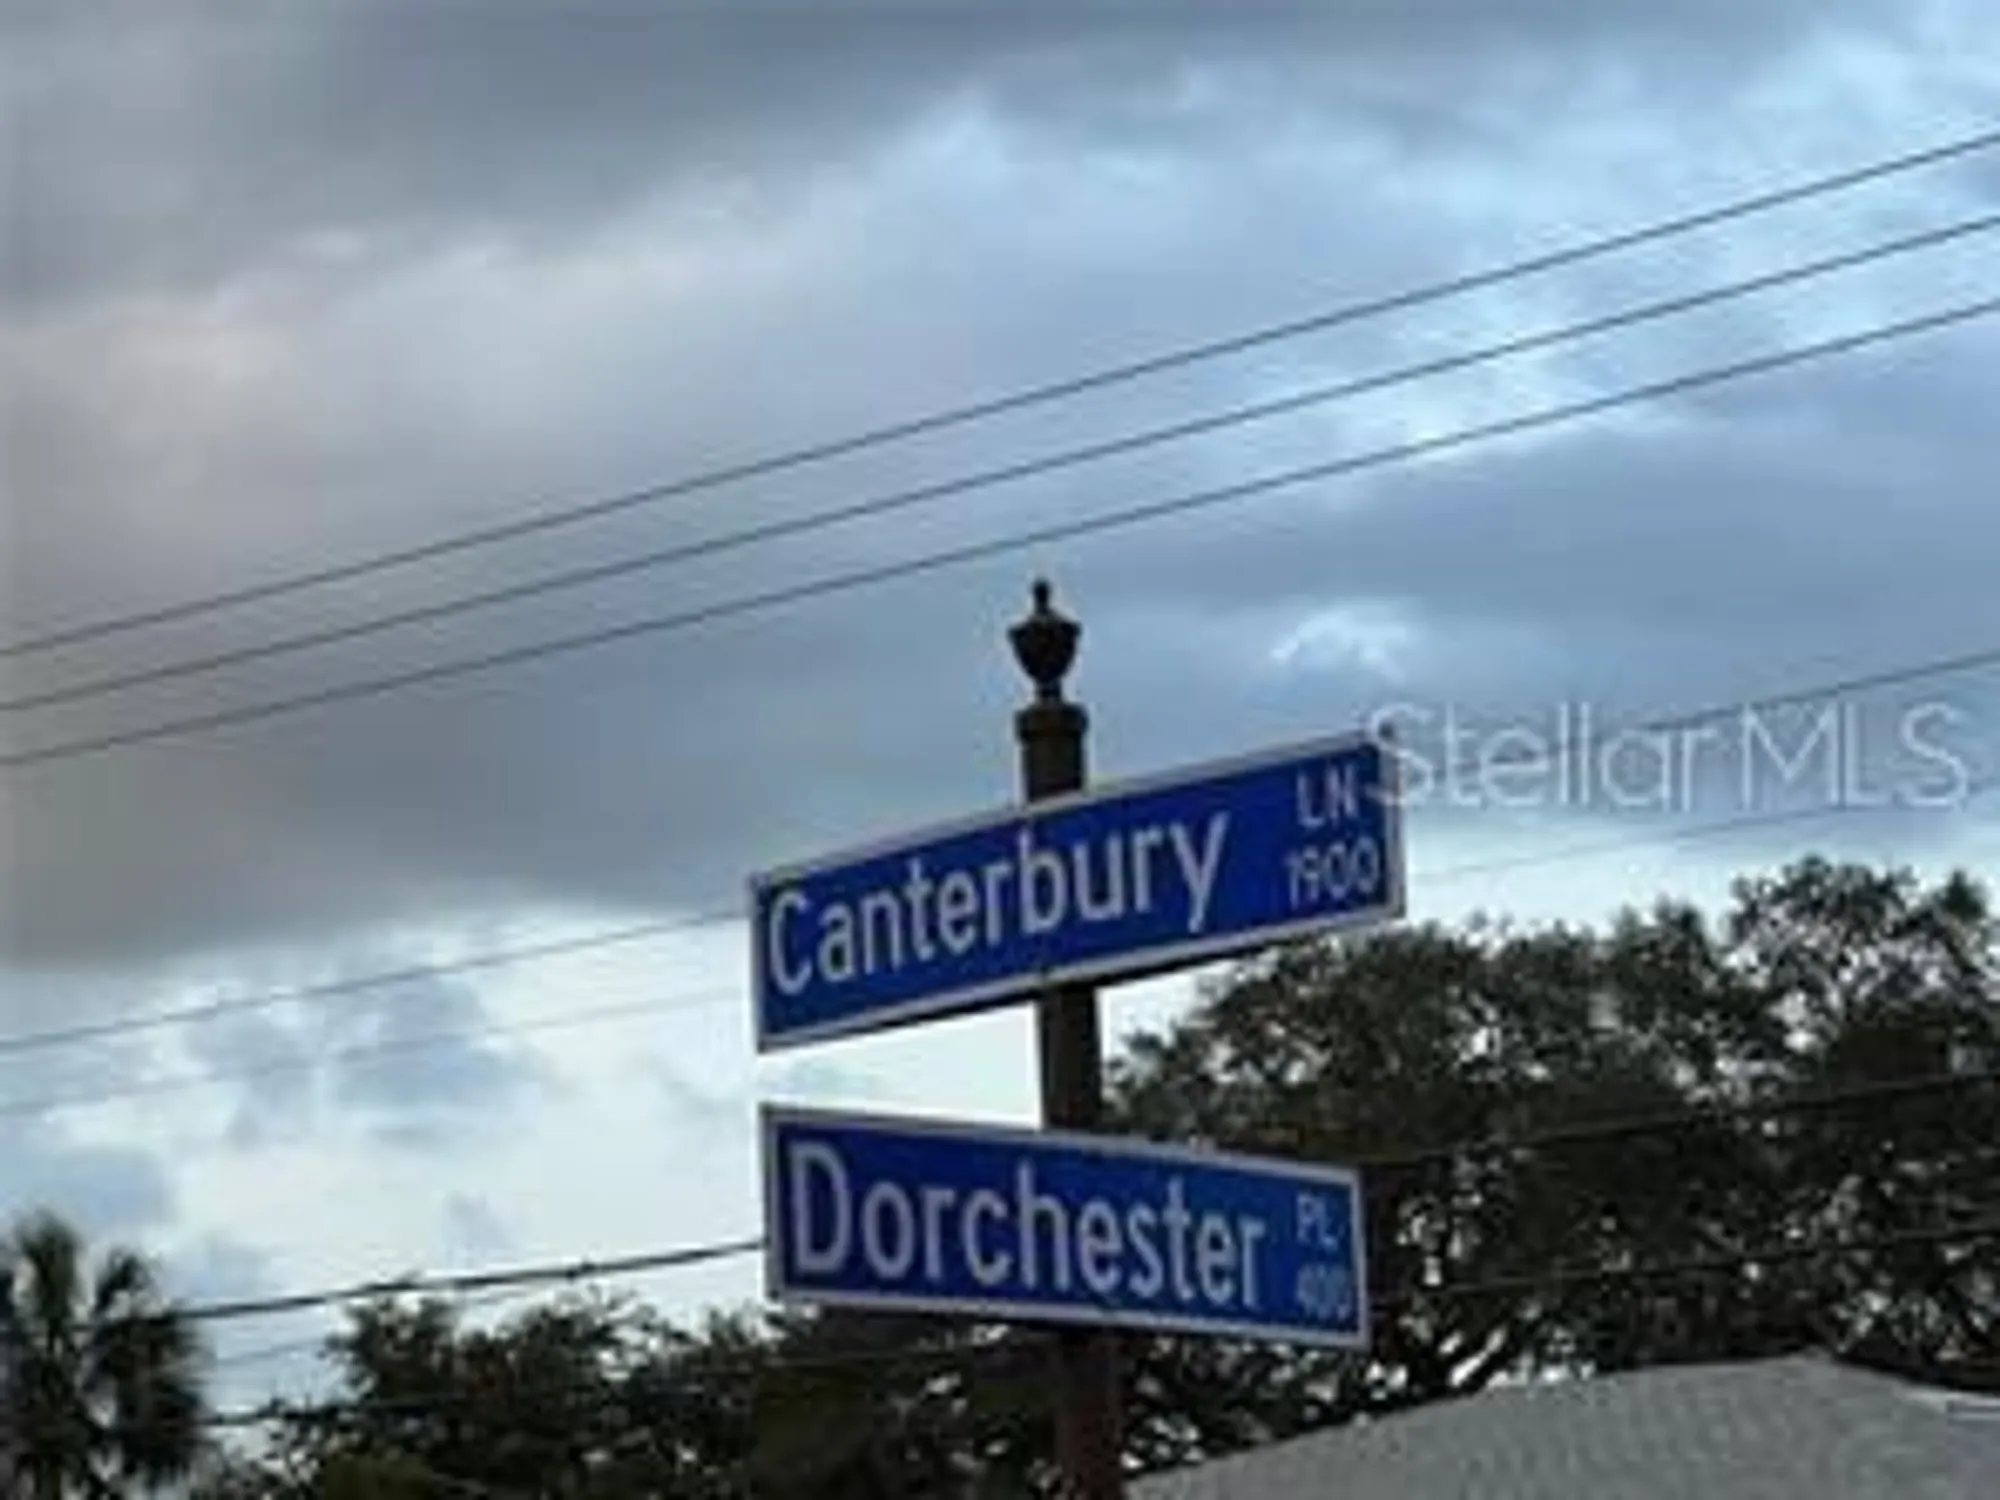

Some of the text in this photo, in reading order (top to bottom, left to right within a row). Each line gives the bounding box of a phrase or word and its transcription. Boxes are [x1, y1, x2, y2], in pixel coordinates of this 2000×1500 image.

[767, 763, 1359, 997] Canterbury LN
[1283, 836, 1381, 910] 1900
[787, 1141, 1267, 1308] Dorchester
